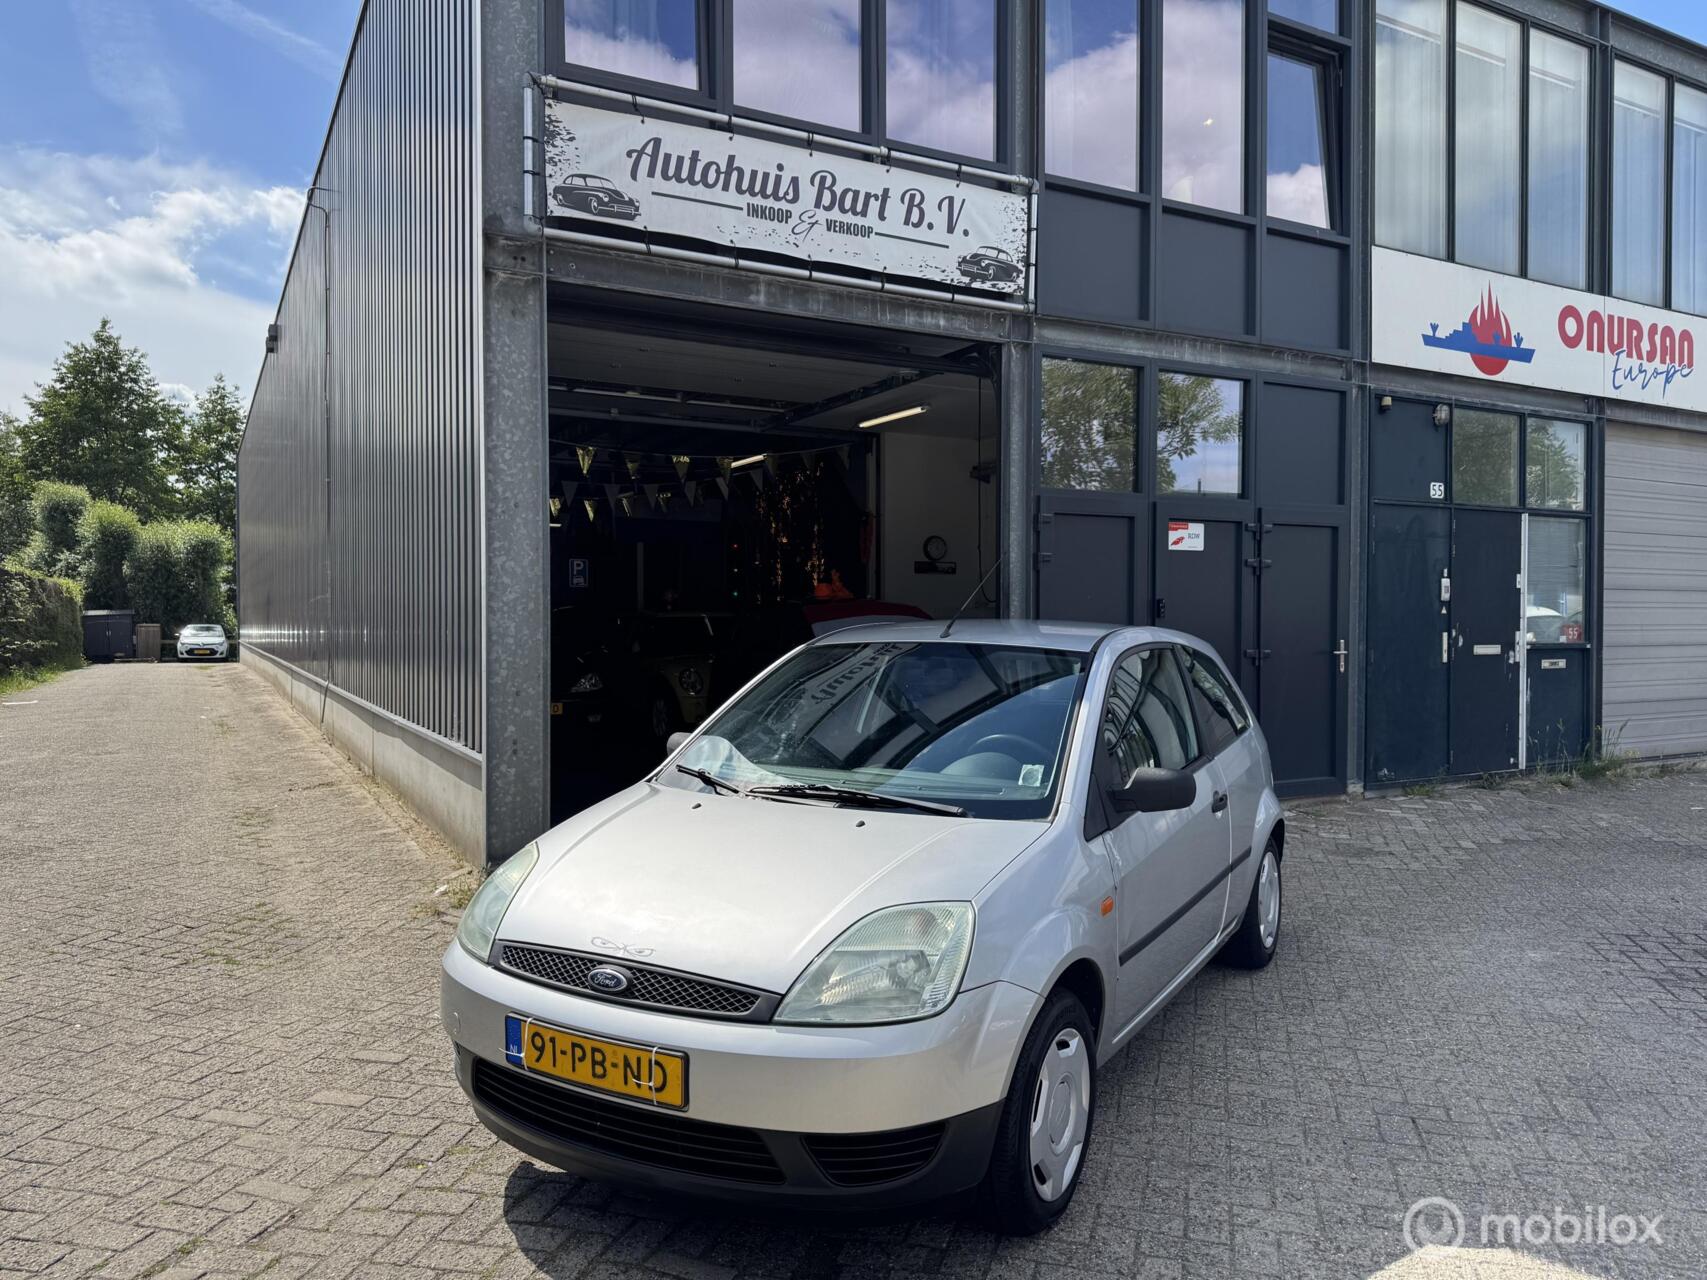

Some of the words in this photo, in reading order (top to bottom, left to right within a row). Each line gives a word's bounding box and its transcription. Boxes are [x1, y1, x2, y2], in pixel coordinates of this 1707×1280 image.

[626, 136, 801, 205] Autohuis
[810, 168, 891, 222] Bart
[900, 188, 970, 238] B.V.
[746, 202, 793, 225] INKOOP
[791, 209, 823, 243] &
[825, 218, 874, 239] VERKOOP
[1557, 304, 1694, 369] ONURSAN
[1611, 349, 1694, 400] Europe
[1432, 484, 1443, 497] 55
[573, 560, 584, 575] P
[1568, 627, 1578, 640] 55
[595, 972, 617, 987] Ford
[531, 1031, 668, 1093] 91-PB-ND
